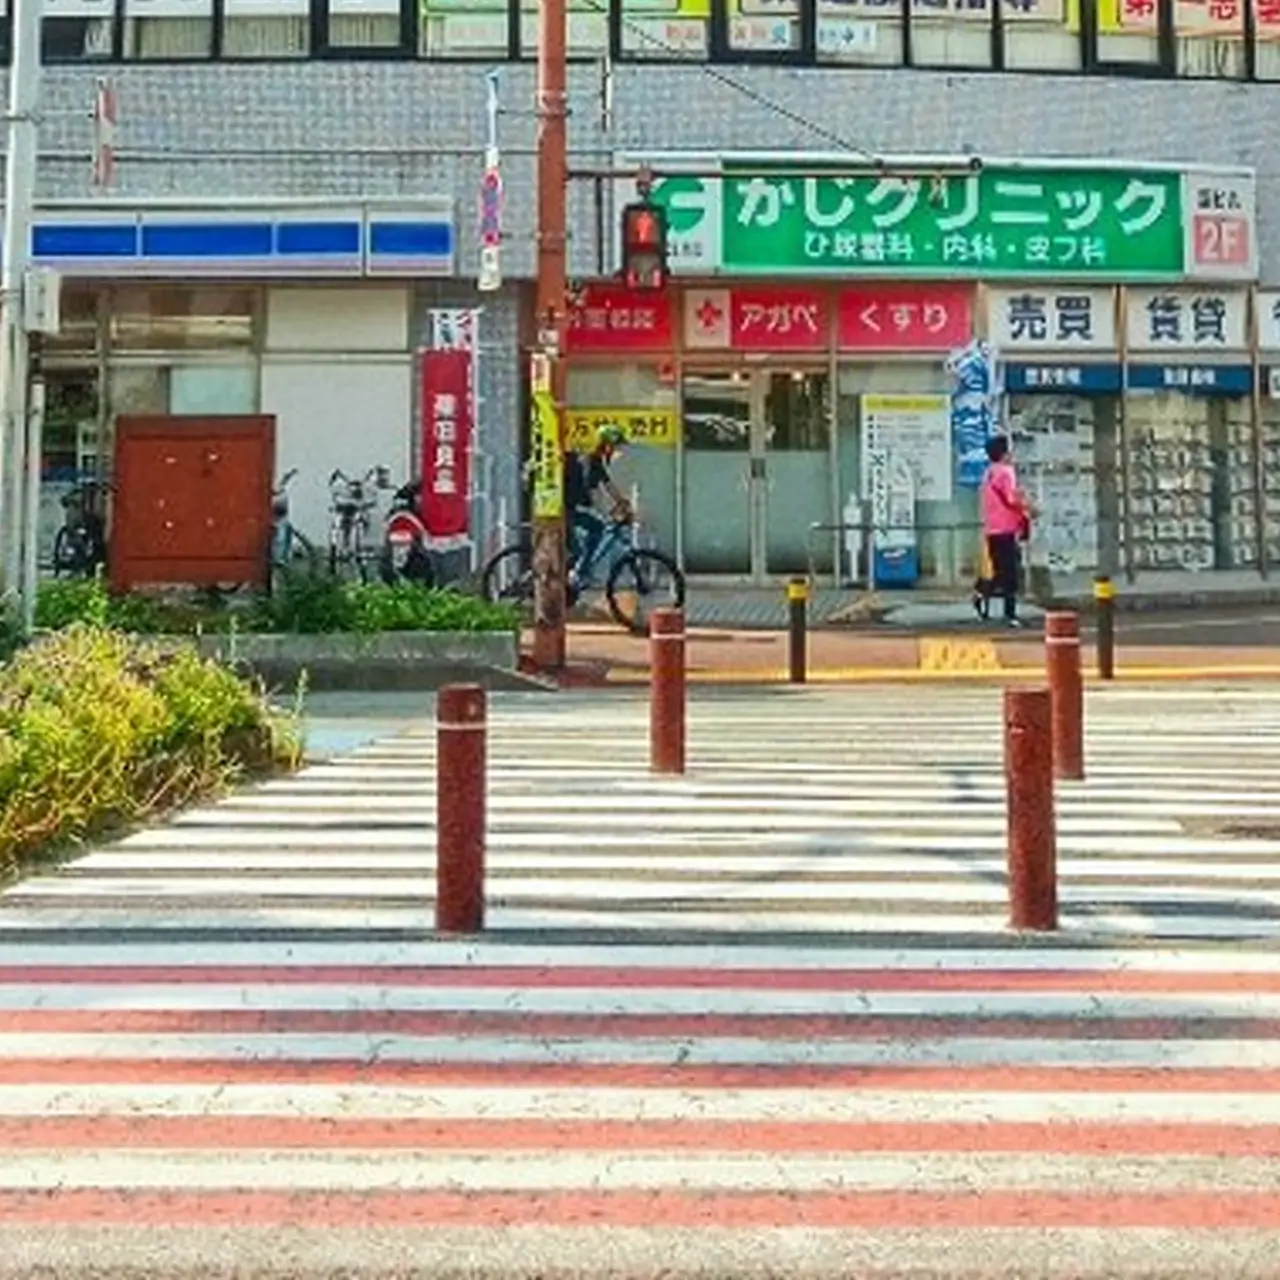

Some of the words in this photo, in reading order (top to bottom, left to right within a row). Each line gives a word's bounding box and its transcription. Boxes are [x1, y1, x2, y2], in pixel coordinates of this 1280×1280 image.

[737, 177, 1167, 236] かじクリニック
[1200, 221, 1242, 260] 2F
[740, 305, 818, 333] アガペ
[858, 306, 949, 334] くすり
[1007, 294, 1094, 342] 売買
[1148, 295, 1226, 343] 賃貸
